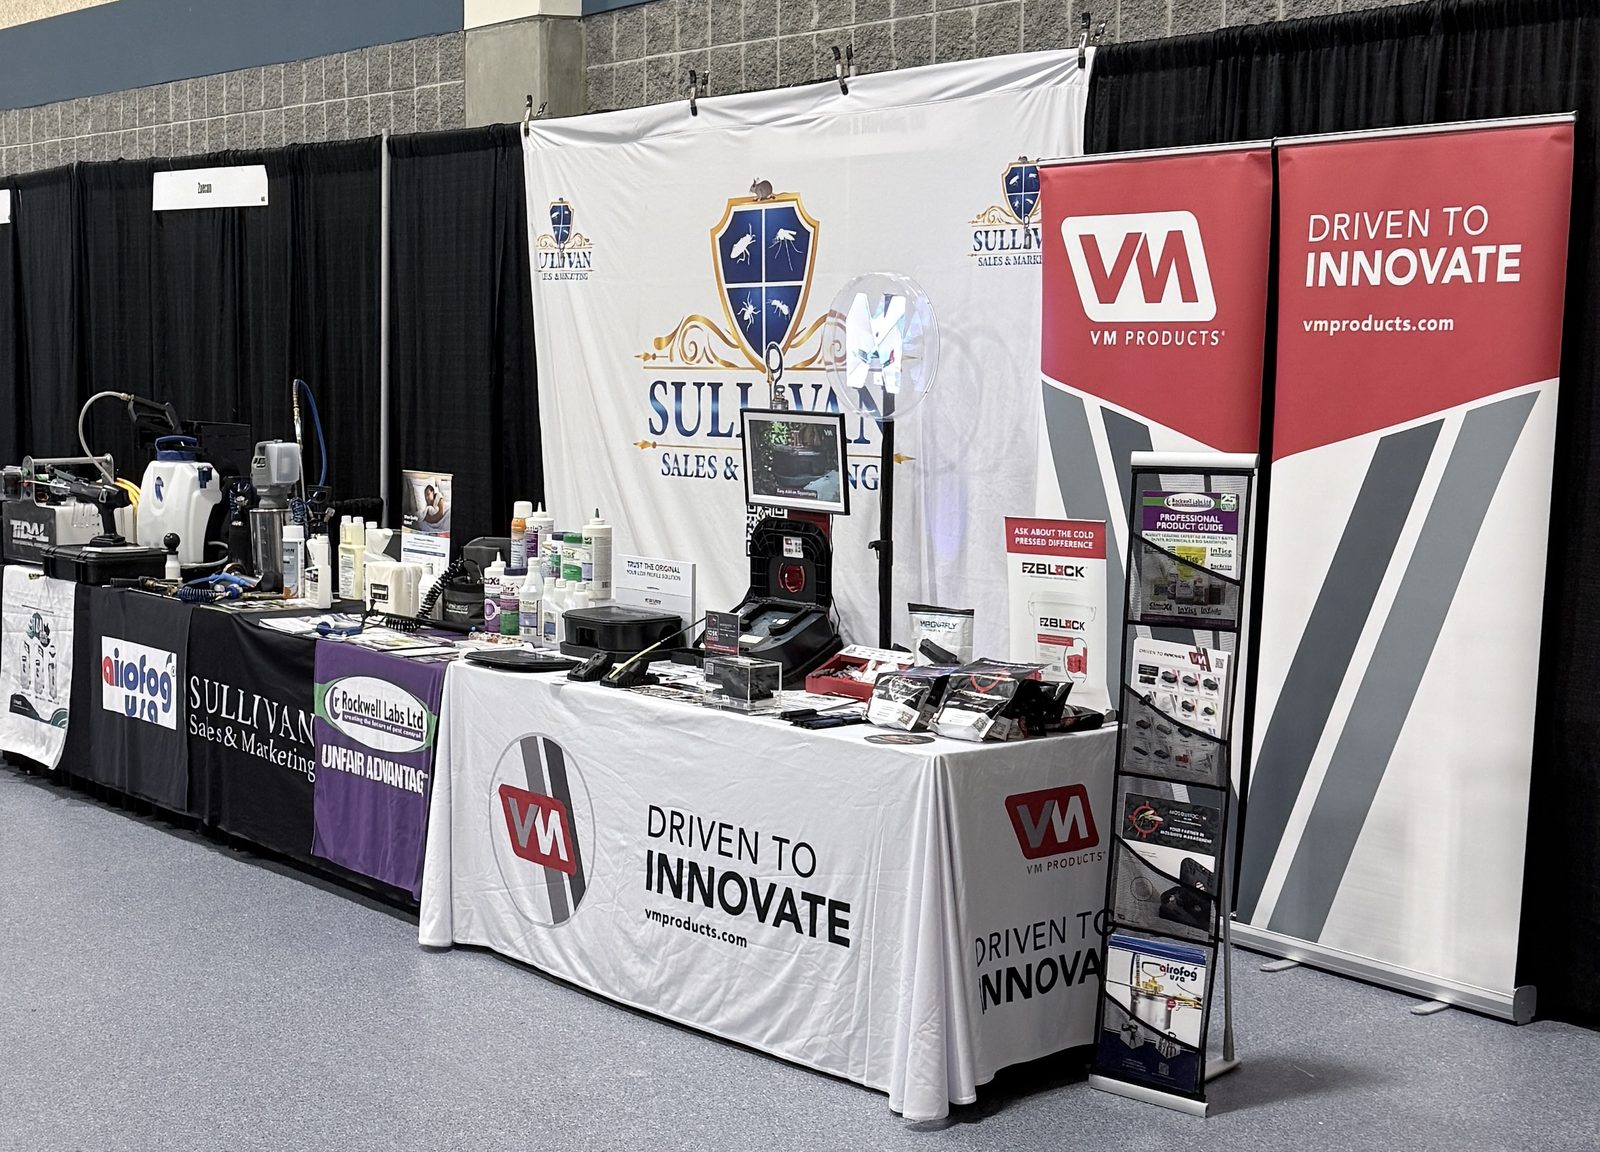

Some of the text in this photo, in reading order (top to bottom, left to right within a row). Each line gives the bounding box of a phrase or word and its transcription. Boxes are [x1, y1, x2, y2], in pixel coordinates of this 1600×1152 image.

[1307, 204, 1490, 243] DRIVEN TO
[978, 256, 1003, 267] SALES
[1004, 256, 1012, 266] &
[1078, 230, 1200, 304] VM
[1304, 243, 1523, 288] INNOVATE
[1090, 329, 1221, 346] VM PRODUCTS
[1302, 314, 1455, 336] vmproducts.com
[661, 452, 739, 481] SALES &
[1014, 528, 1094, 539] ASK ABOUT THE COLD
[1156, 521, 1224, 532] PRODUCT GUIDE
[1160, 513, 1220, 524] PROFESSIONAL
[1015, 537, 1093, 549] PRESSED DIFFERENCE
[102, 647, 173, 713] airofog
[124, 694, 158, 724] usa
[190, 675, 316, 747] SULLIVAN
[342, 690, 424, 730] Rockwell Labs Ltd
[241, 730, 316, 783] Marketing
[321, 743, 365, 777] UNFAIR
[507, 796, 569, 862] VM
[1016, 794, 1089, 849] VM
[646, 804, 817, 879] DRIVEN TO
[1026, 852, 1103, 875] VM PRODUCTS
[645, 849, 851, 948] INNOVATE
[644, 907, 748, 948] vmproducts.com
[975, 908, 1117, 968] DRIVEN TO
[1159, 963, 1198, 982] airofog
[1169, 974, 1185, 983] usa
